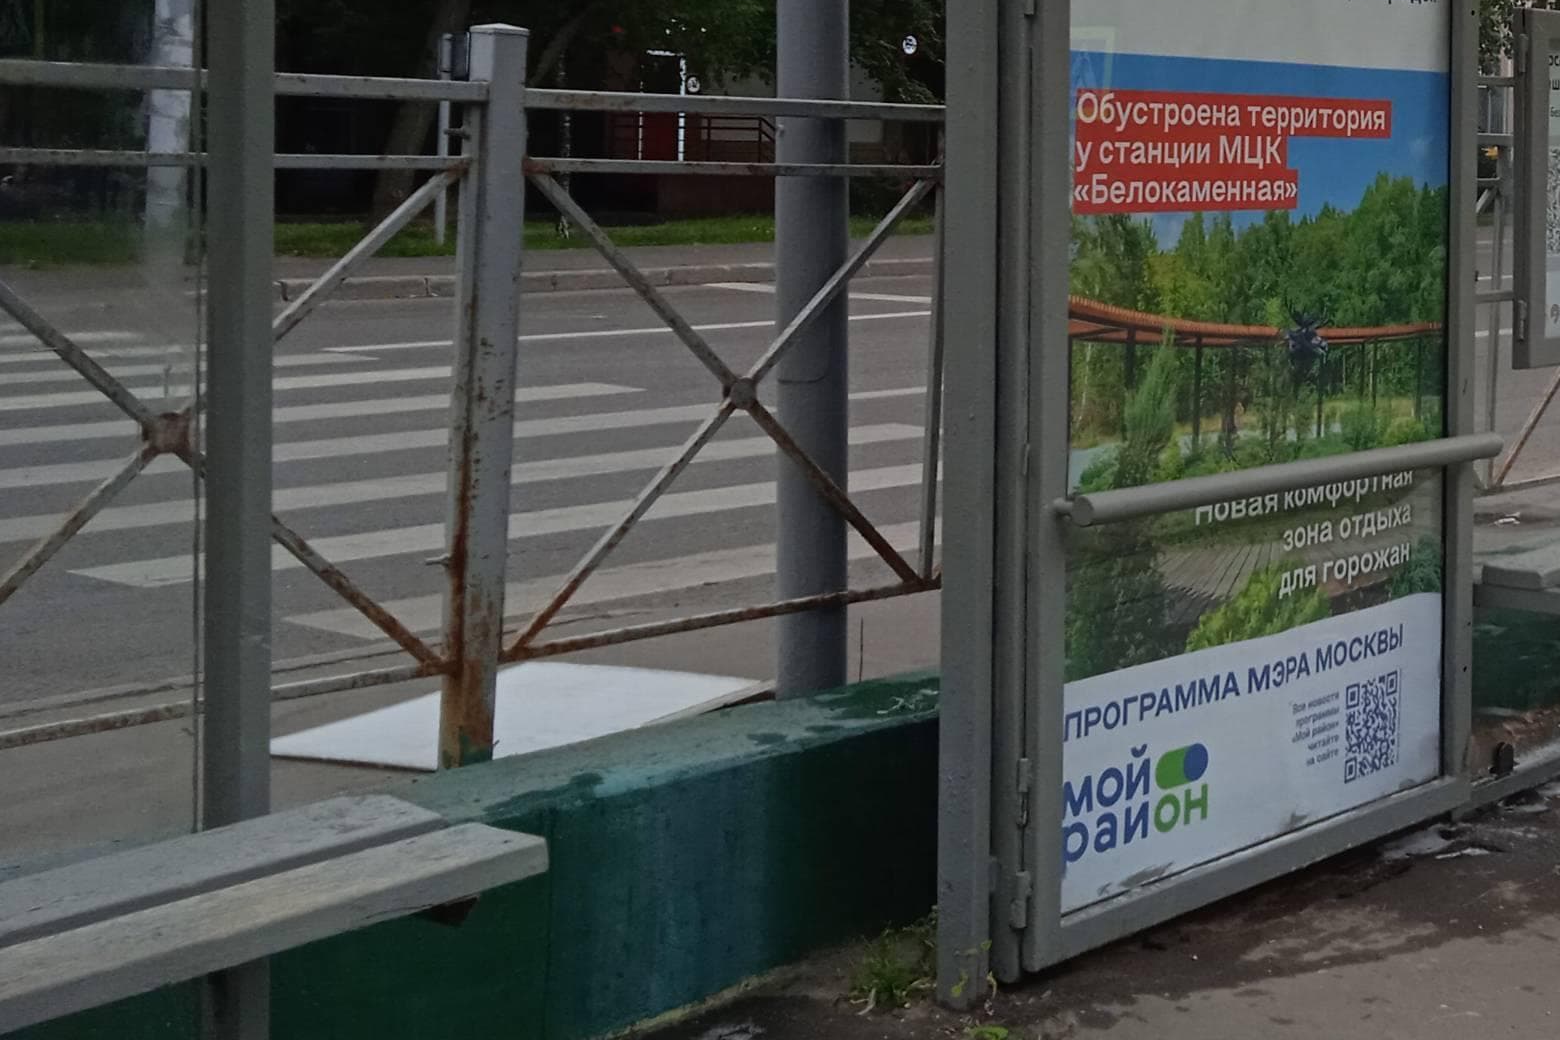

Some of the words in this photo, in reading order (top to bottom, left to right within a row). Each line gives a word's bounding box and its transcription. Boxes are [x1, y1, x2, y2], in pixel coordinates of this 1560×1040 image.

[1549, 79, 1560, 91] ш
[1076, 92, 1240, 132] Обустроена
[1247, 104, 1386, 135] территория
[1076, 140, 1092, 172] у
[1100, 140, 1210, 165] станции
[1218, 135, 1282, 169] МЦК
[1073, 173, 1298, 204] «Белокаменная»
[1195, 493, 1278, 526] Новая
[1283, 470, 1413, 507] комфортная
[1283, 521, 1333, 552] зона
[1339, 503, 1411, 539] отдыха
[1278, 565, 1316, 599] для
[1322, 542, 1411, 584] горожан
[1063, 675, 1241, 743] ПРОГРАММА
[1247, 652, 1311, 697] МЭРА
[1315, 624, 1404, 675] МОСКВЫ
[1063, 744, 1150, 820] мой
